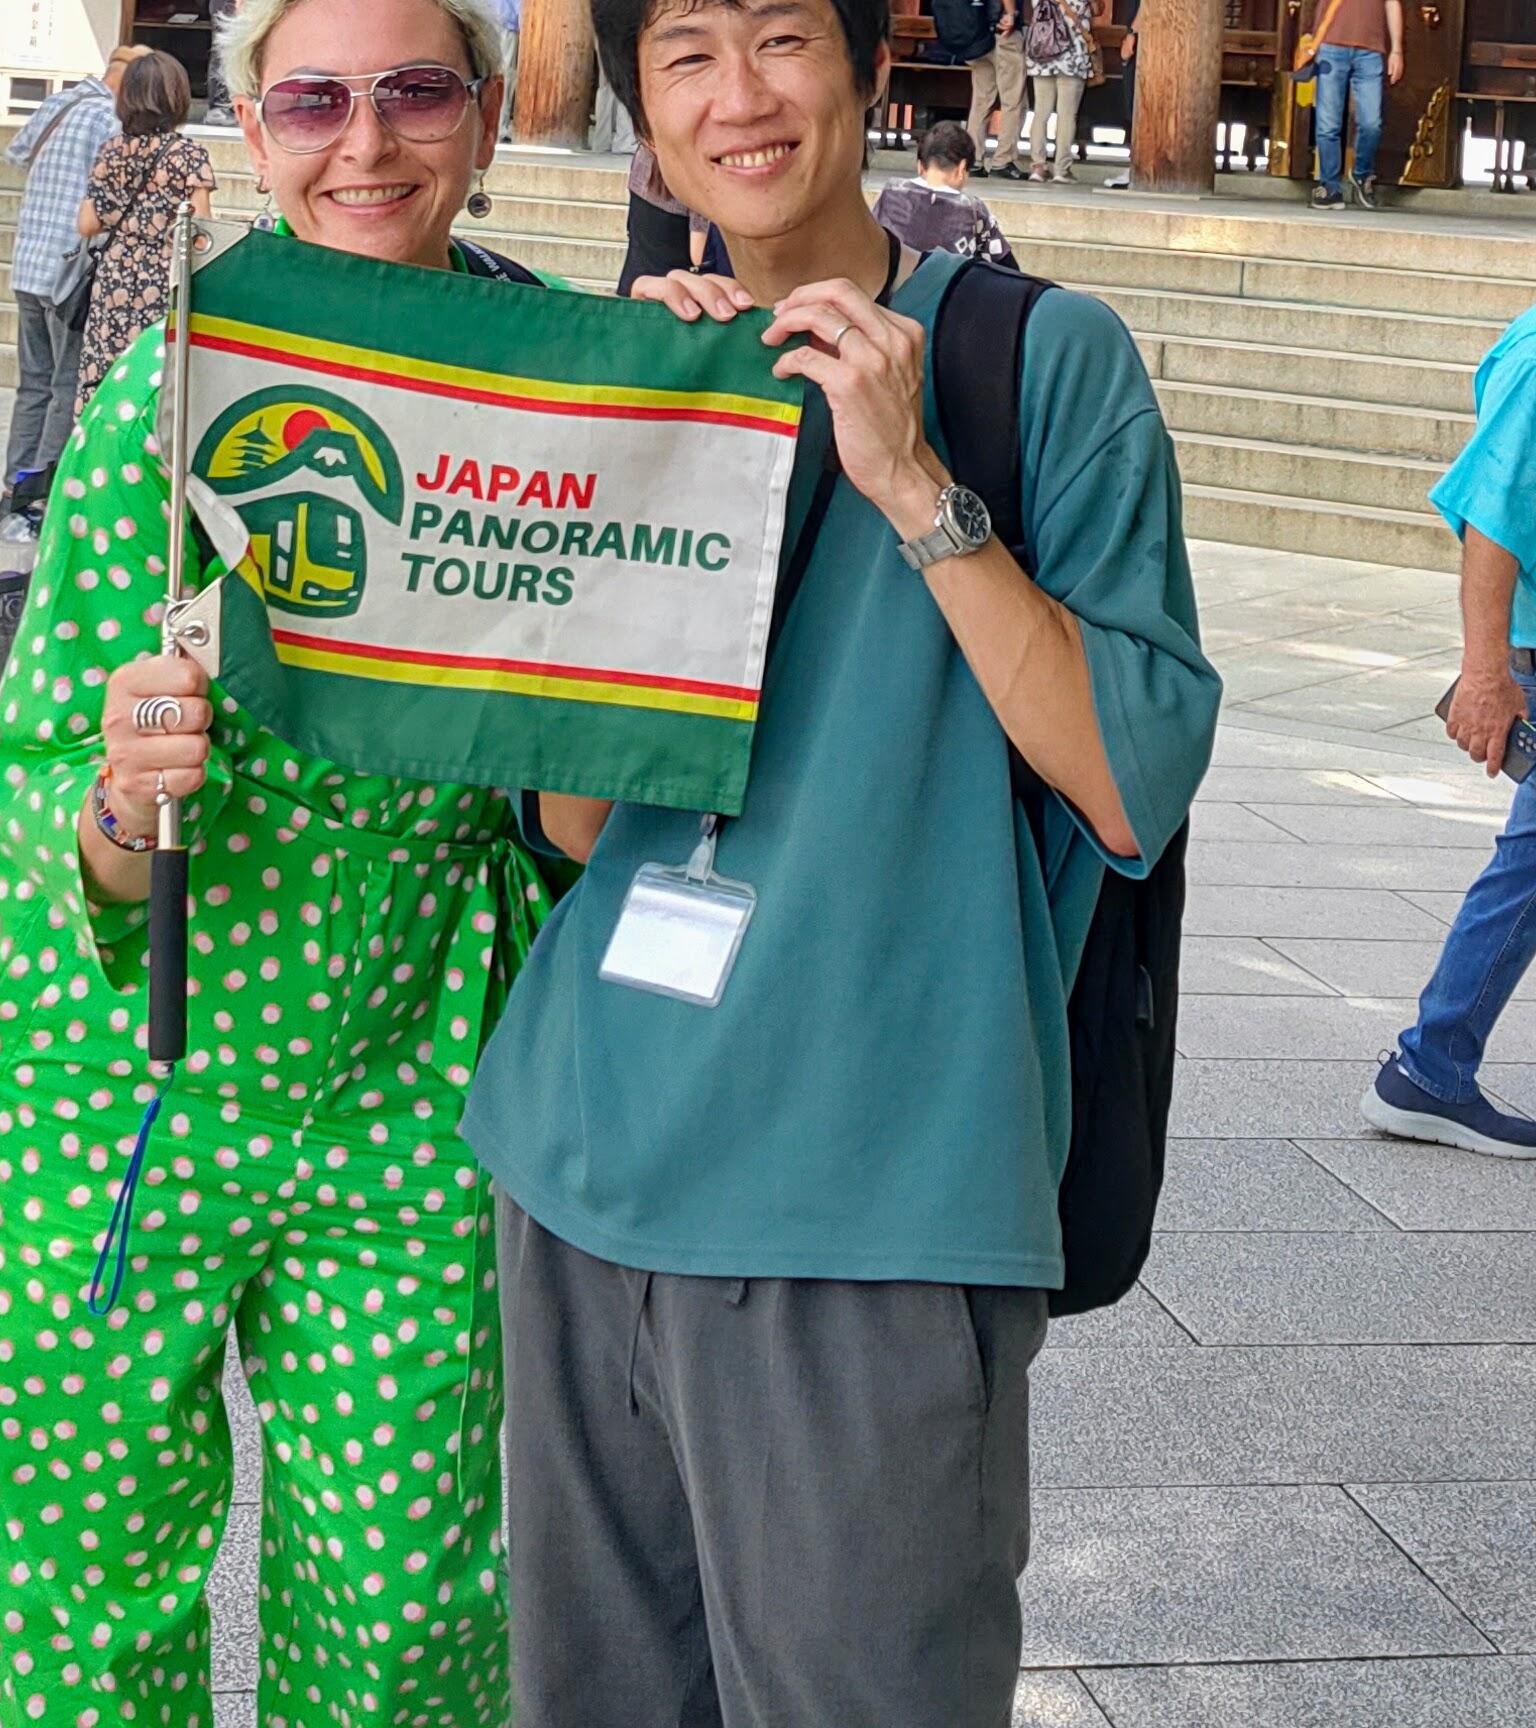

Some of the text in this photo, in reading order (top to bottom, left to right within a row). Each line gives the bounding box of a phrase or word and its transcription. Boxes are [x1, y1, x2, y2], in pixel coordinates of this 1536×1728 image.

[416, 454, 597, 509] JAPAN
[409, 502, 731, 571] PANORAMIC
[401, 552, 575, 605] TOURS
